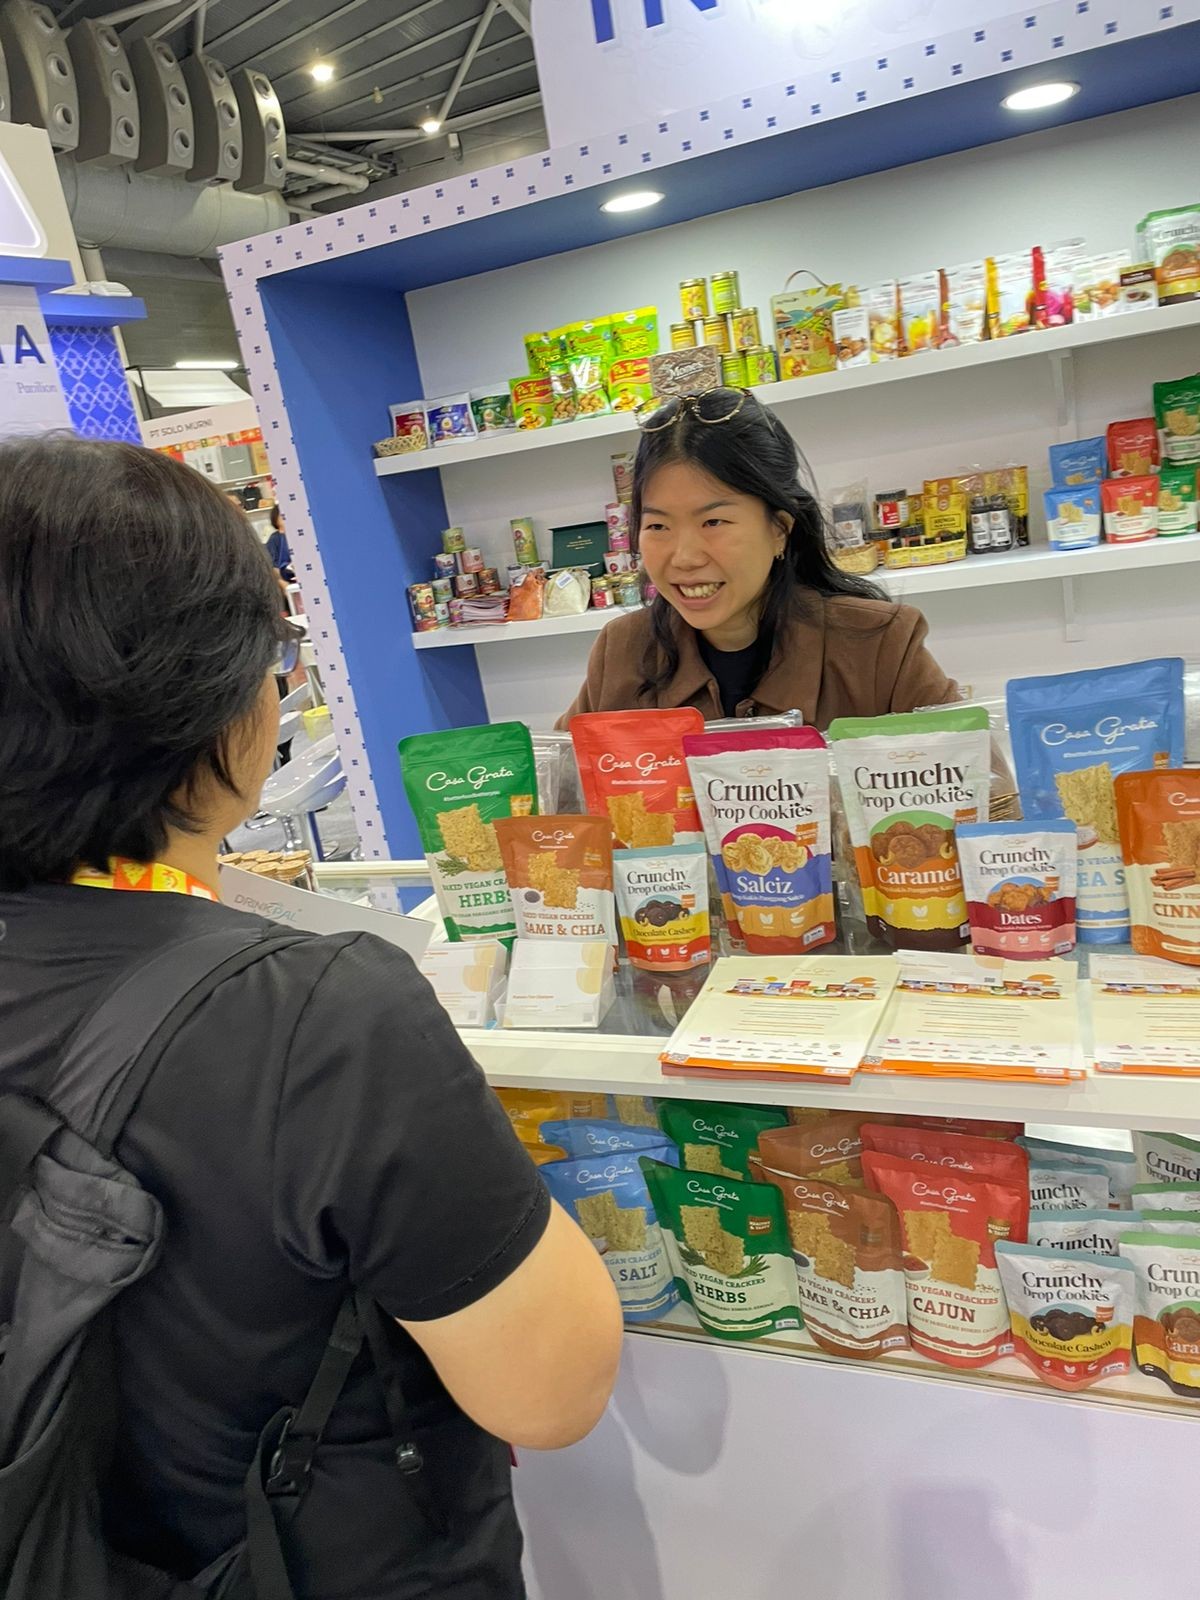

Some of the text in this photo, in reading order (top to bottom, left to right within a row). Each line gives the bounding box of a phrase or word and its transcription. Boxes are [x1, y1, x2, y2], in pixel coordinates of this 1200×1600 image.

[161, 424, 184, 437] SOLO
[1041, 716, 1158, 745] Casa Grata
[598, 752, 682, 776] Casa Grata
[426, 766, 514, 791] Casa Grata
[854, 762, 970, 790] Crunchy
[707, 778, 808, 803] Crunchy
[899, 786, 974, 807] Cookies
[749, 802, 813, 820] Cookies
[980, 847, 1053, 865] Crunchy
[627, 868, 689, 884] Crunchy
[877, 862, 960, 885] Caramel
[980, 862, 1056, 877] Drop Cookies
[627, 882, 692, 895] Drop Cookies
[736, 876, 794, 894] Salciz
[1076, 871, 1107, 888] EA
[1000, 913, 1042, 925] Dates
[557, 923, 567, 935] &
[571, 923, 606, 936] CHIA
[1030, 1184, 1084, 1201] unchy
[619, 1262, 658, 1282] SALT
[699, 1273, 723, 1285] VEGAN
[725, 1277, 766, 1289] CRACKERS
[1022, 1271, 1104, 1289] Crunchy
[693, 1280, 747, 1304] HERBS
[808, 1279, 833, 1295] VEGAN
[834, 1290, 877, 1304] CRACKERS
[920, 1285, 952, 1298] VEGAN
[953, 1292, 999, 1305] CRACKERS
[1023, 1286, 1110, 1303] Drop Cookies
[1148, 1281, 1182, 1299] Drop
[832, 1299, 845, 1314] &
[848, 1304, 891, 1320] CHIA
[913, 1297, 976, 1323] CAJUN
